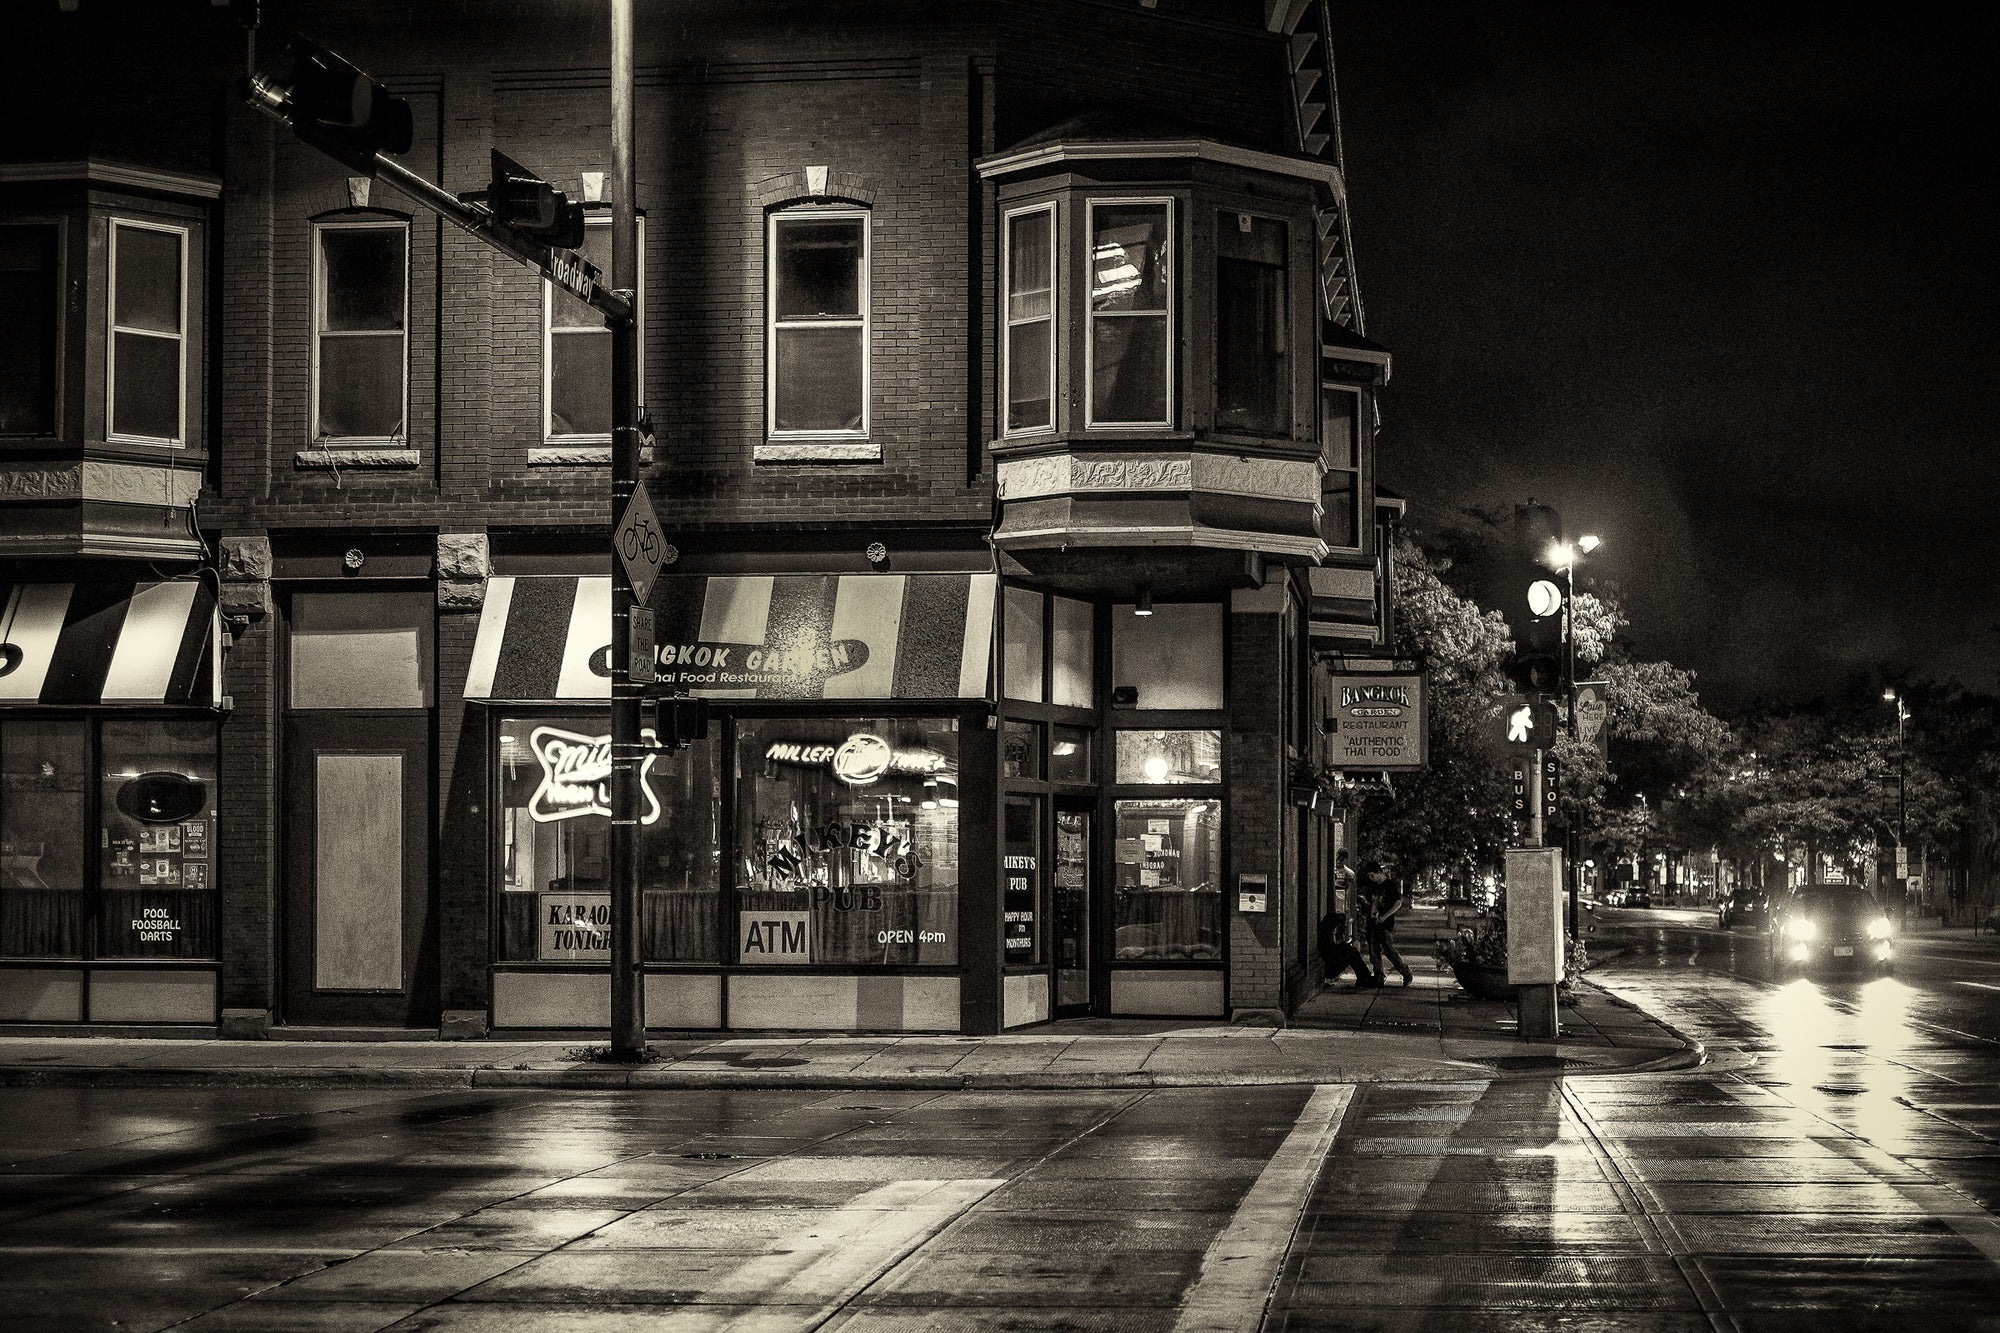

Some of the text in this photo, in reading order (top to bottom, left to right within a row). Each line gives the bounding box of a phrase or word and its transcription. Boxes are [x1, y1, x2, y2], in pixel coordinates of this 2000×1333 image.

[551, 247, 594, 303] roadway
[632, 616, 652, 632] SHARE
[637, 637, 648, 652] THE
[634, 657, 651, 674] ROAD
[746, 644, 849, 672] GAREN
[654, 672, 676, 683] hai
[680, 672, 716, 683] Food
[1340, 685, 1411, 709] BANGKOK
[1357, 708, 1397, 716] GARDEN
[1342, 721, 1409, 730] RESTAURANT
[766, 744, 835, 763] MILLER
[1344, 747, 1368, 757] THAI
[1514, 770, 1524, 809] BUS
[1547, 762, 1557, 816] STOP
[1010, 877, 1028, 890] PUB
[809, 886, 883, 912] PUB
[143, 908, 169, 918] POOL
[548, 904, 612, 925] KARAO
[132, 920, 181, 930] FOOSBALL
[140, 931, 172, 941] DARTS
[553, 929, 612, 950] TONIGH
[745, 921, 806, 954] ATM
[877, 930, 946, 945] OPEN 4pm
